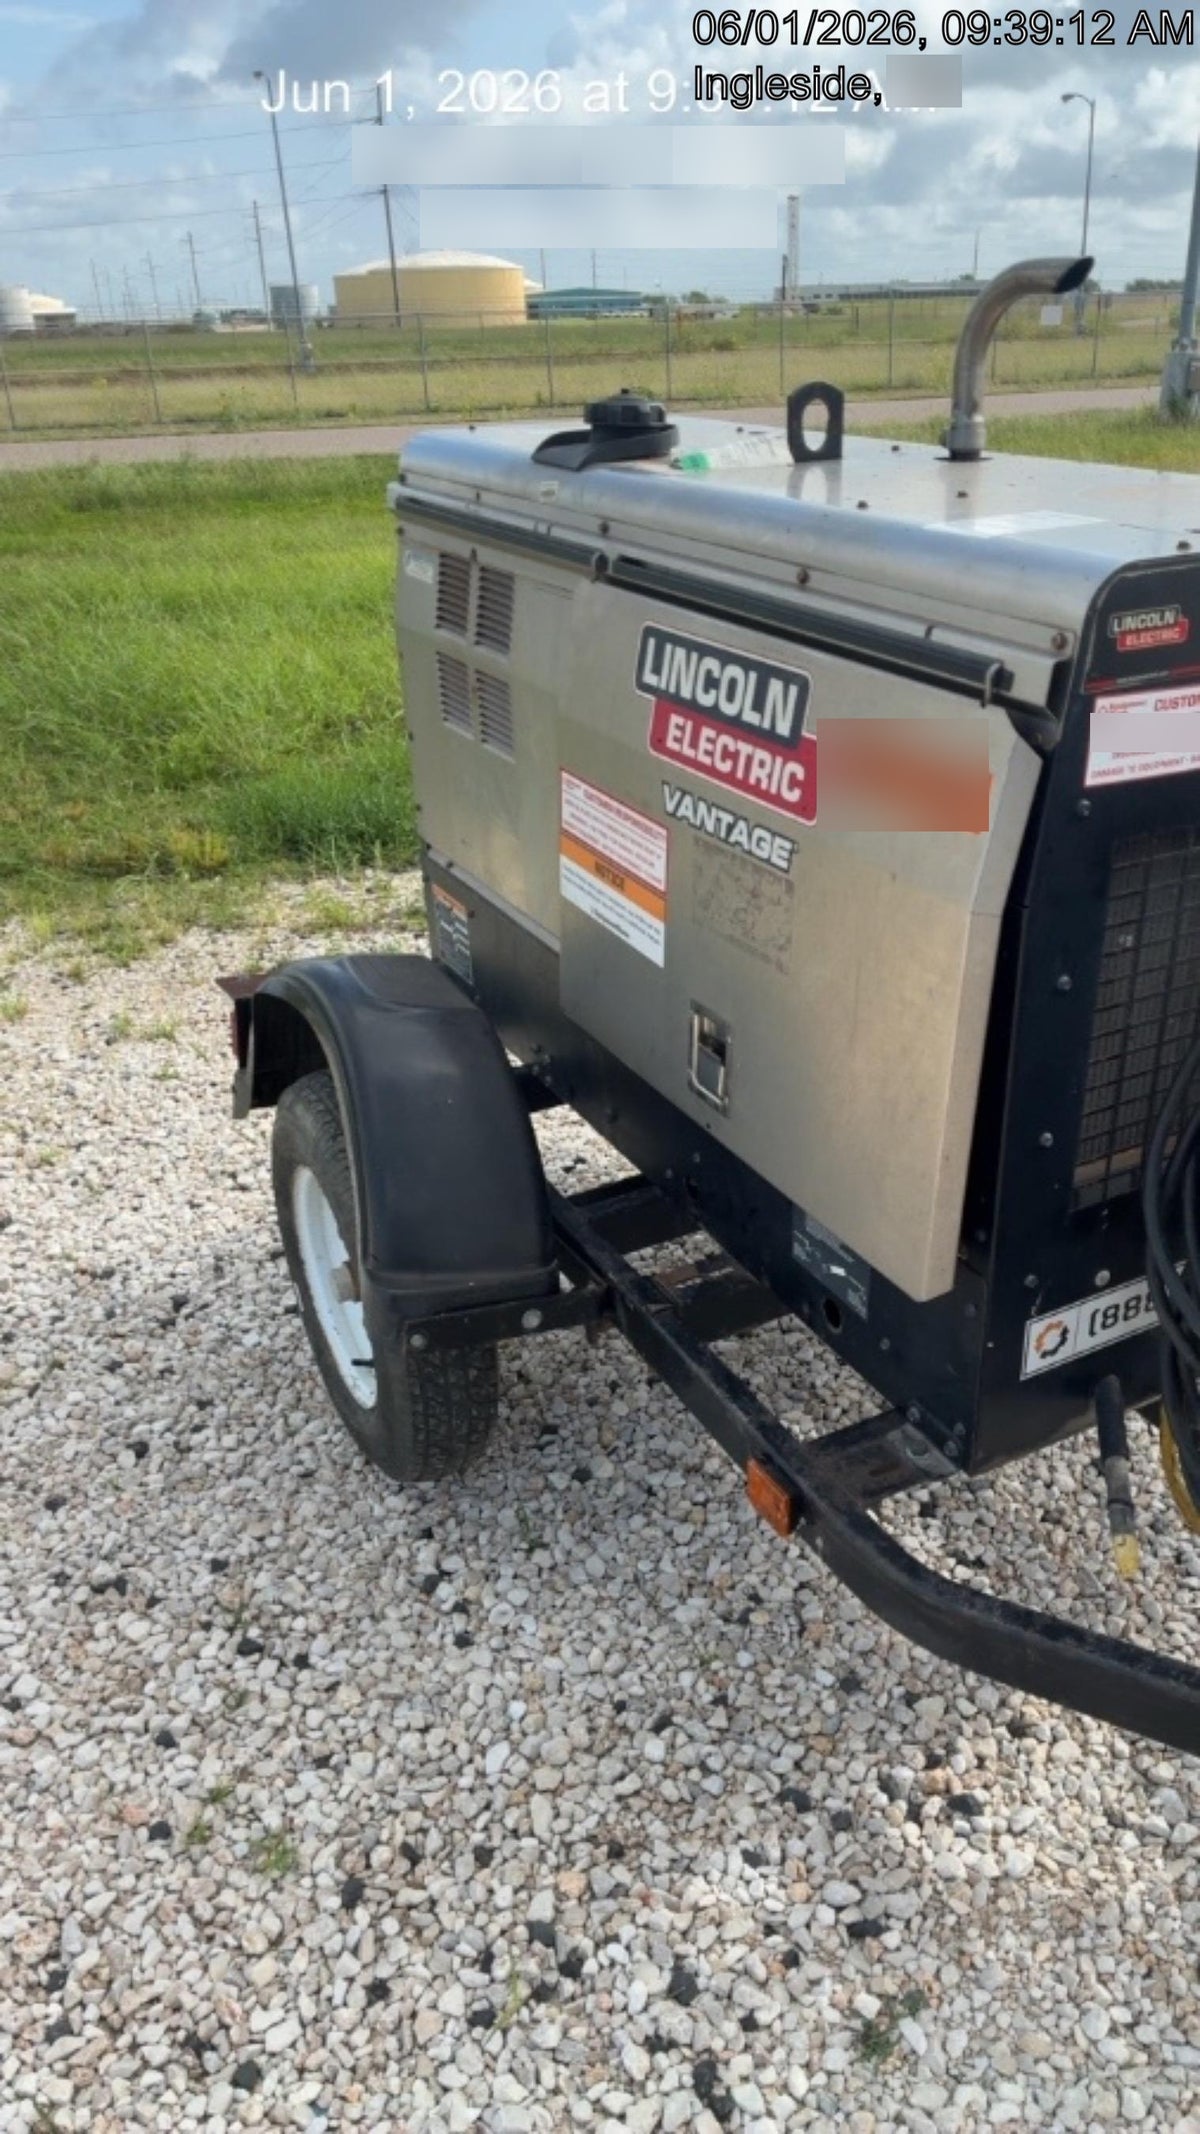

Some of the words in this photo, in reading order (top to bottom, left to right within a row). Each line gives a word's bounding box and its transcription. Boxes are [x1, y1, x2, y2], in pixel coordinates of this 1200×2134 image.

[1113, 609, 1176, 632] LINCOLN
[642, 637, 798, 738] LINCOLN
[666, 713, 805, 802] ELECTRIC
[662, 780, 793, 872] VANTAGE
